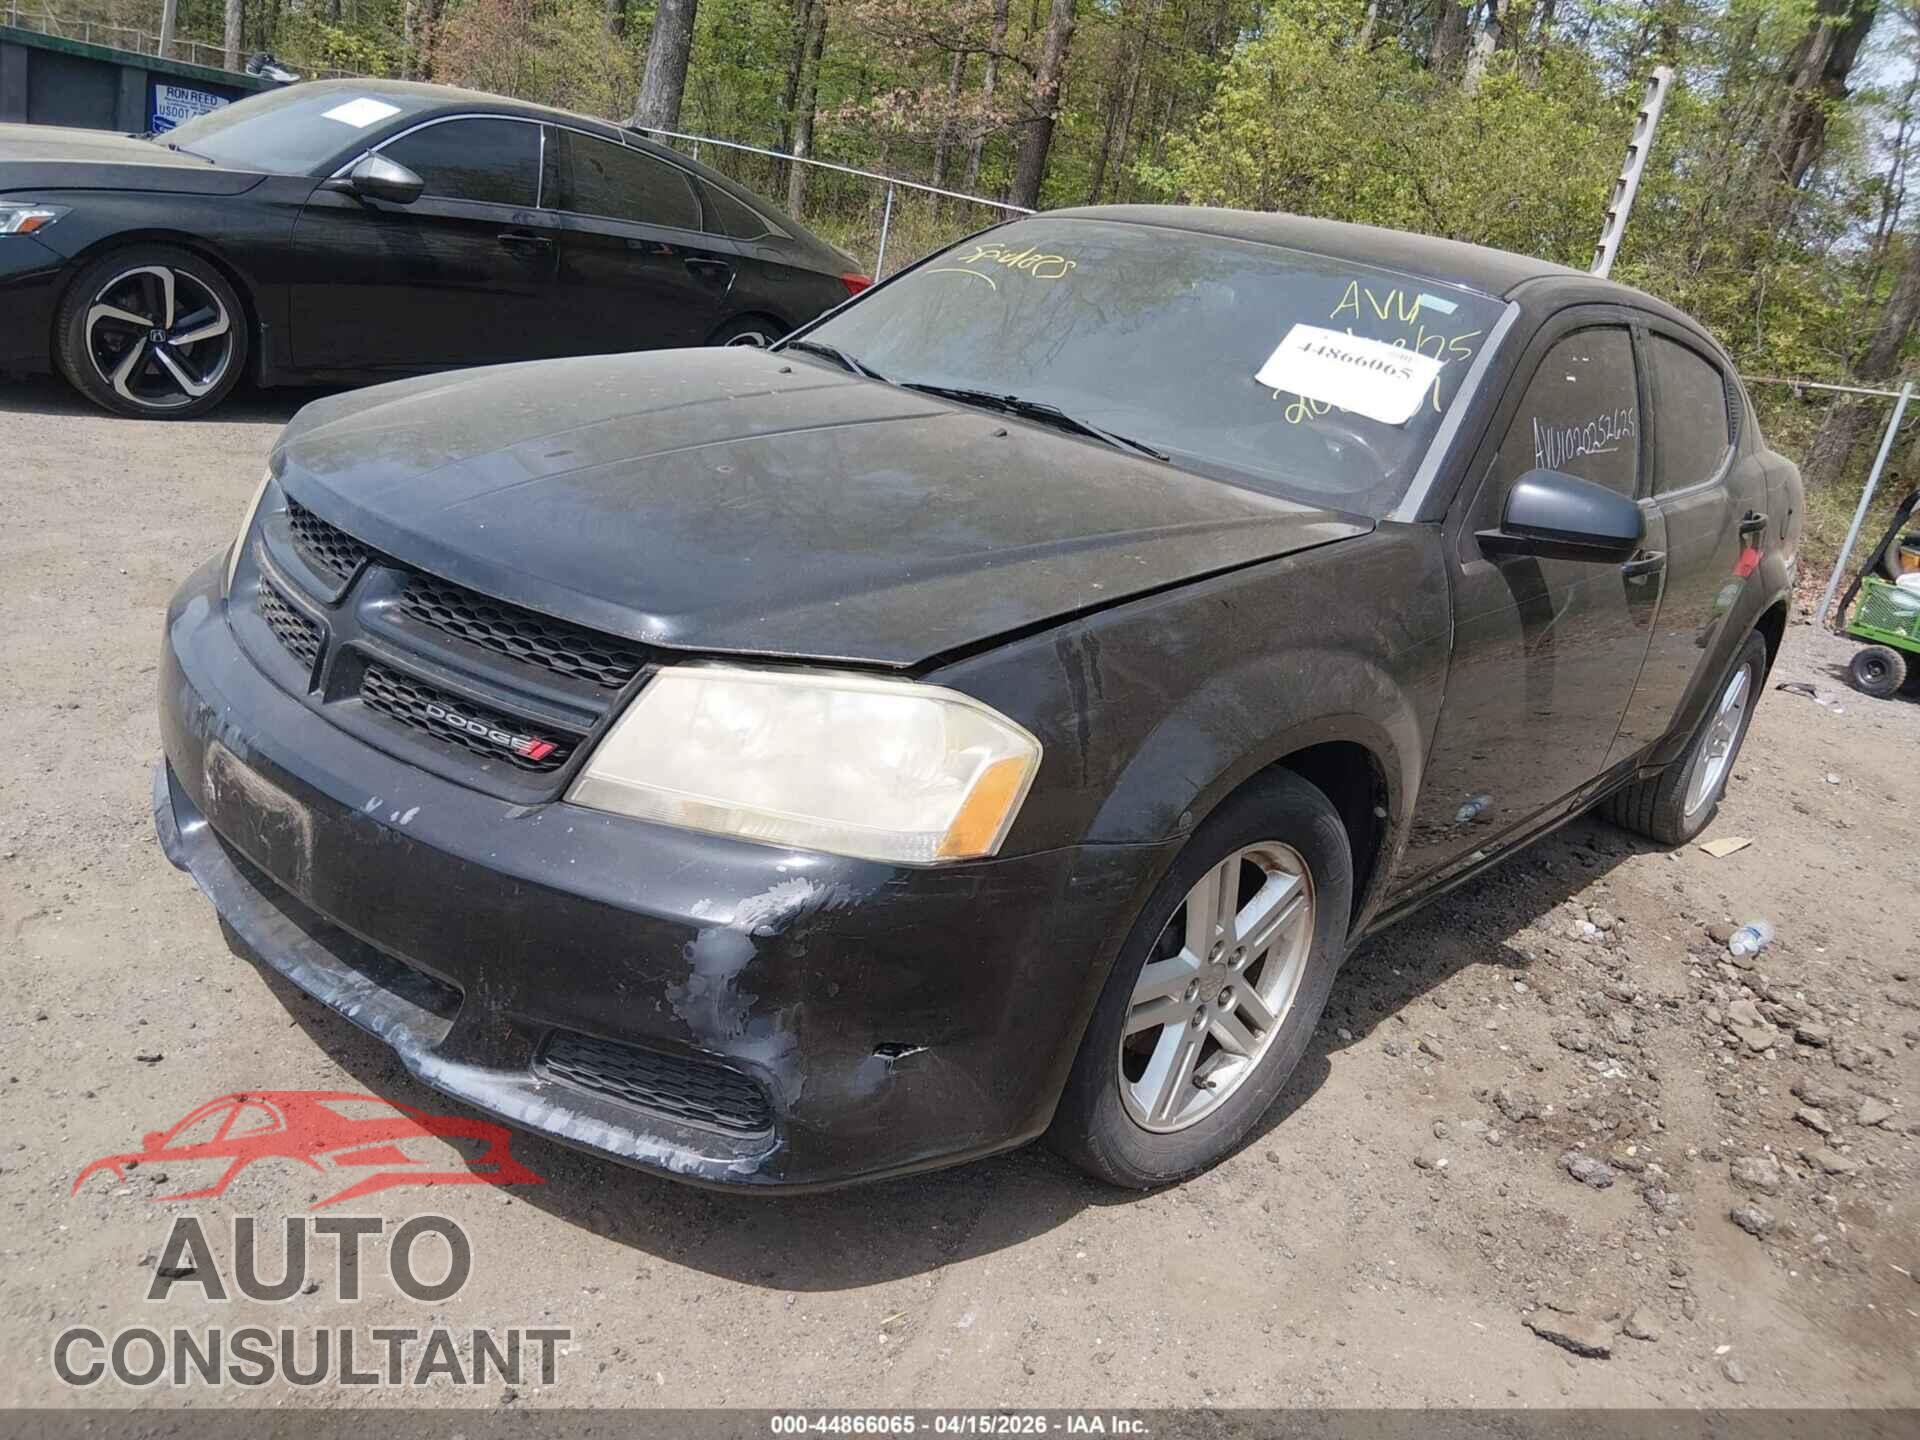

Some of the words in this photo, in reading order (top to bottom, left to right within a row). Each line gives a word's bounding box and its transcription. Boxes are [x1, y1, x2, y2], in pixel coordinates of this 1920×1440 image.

[166, 86, 189, 101] RON
[190, 91, 218, 106] REED
[426, 703, 535, 754] DODGE
